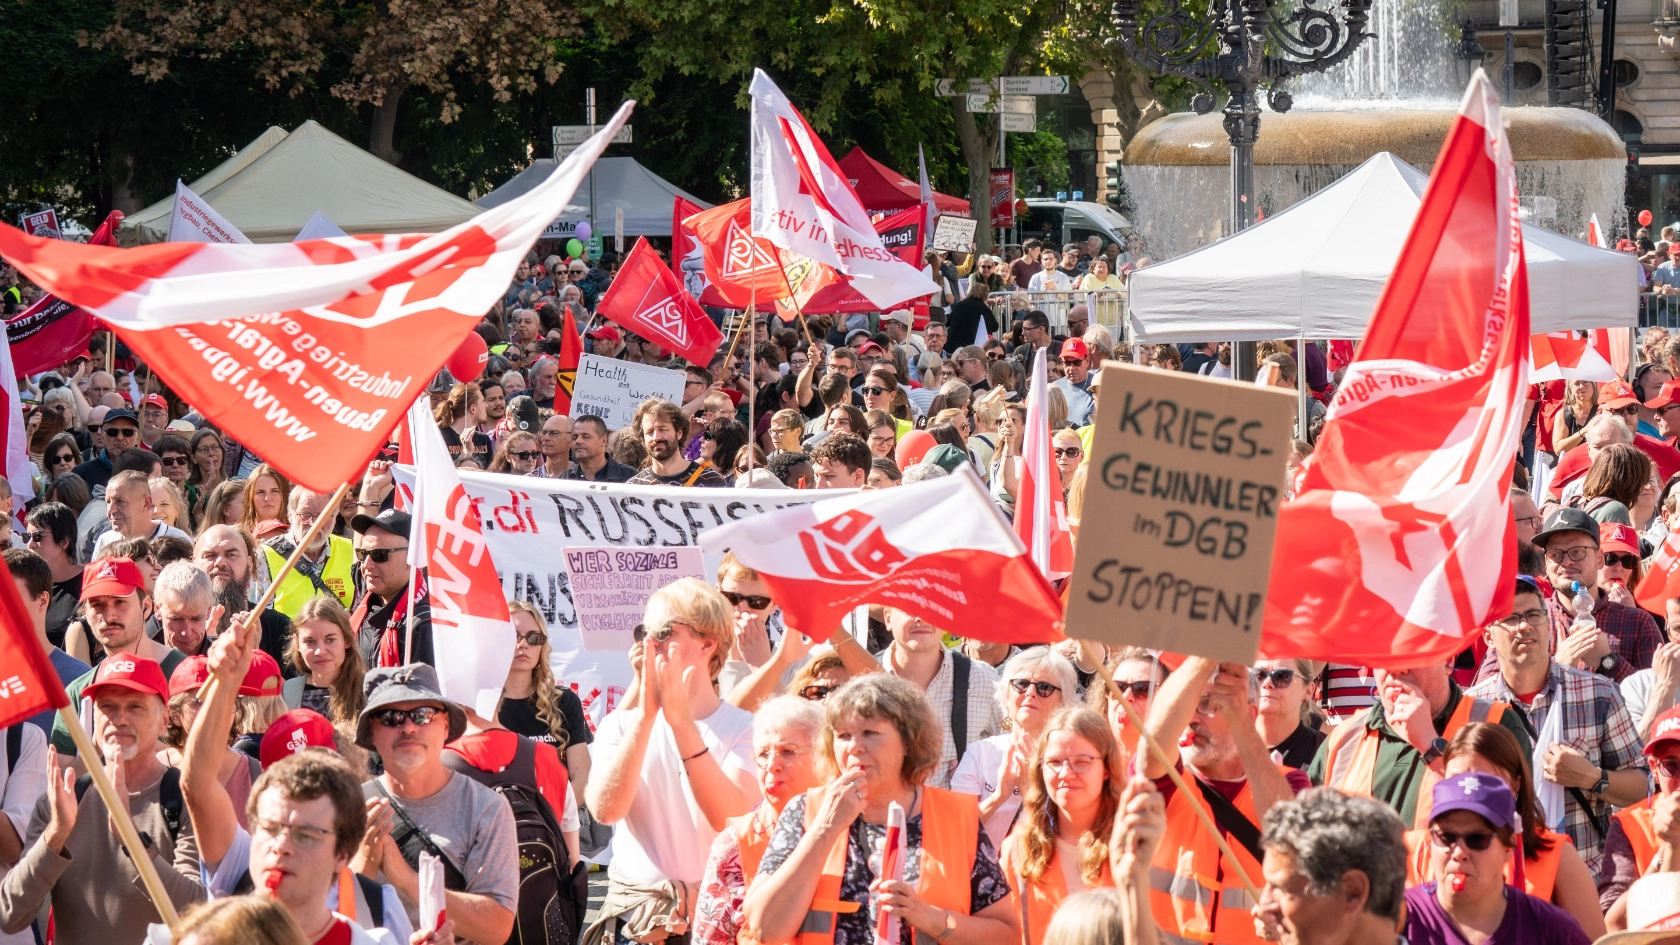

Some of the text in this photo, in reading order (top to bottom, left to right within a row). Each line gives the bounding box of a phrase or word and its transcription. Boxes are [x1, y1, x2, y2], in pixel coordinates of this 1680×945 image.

[30, 213, 49, 227] GELD
[584, 360, 628, 382] Health
[579, 389, 620, 406] Gesundheit
[575, 402, 611, 419] KEINE
[1119, 391, 1275, 460] KRIEGS-
[1101, 452, 1279, 520] GEWINNLER
[1133, 510, 1249, 561] im DGB
[567, 550, 678, 574] WER SOZIALE
[570, 571, 654, 593] SICHERHEIT
[575, 590, 650, 609] VERSCHÄRFT
[1086, 558, 1263, 632] STOPPEN!
[104, 660, 136, 677] DGB
[286, 733, 308, 751] GEW
